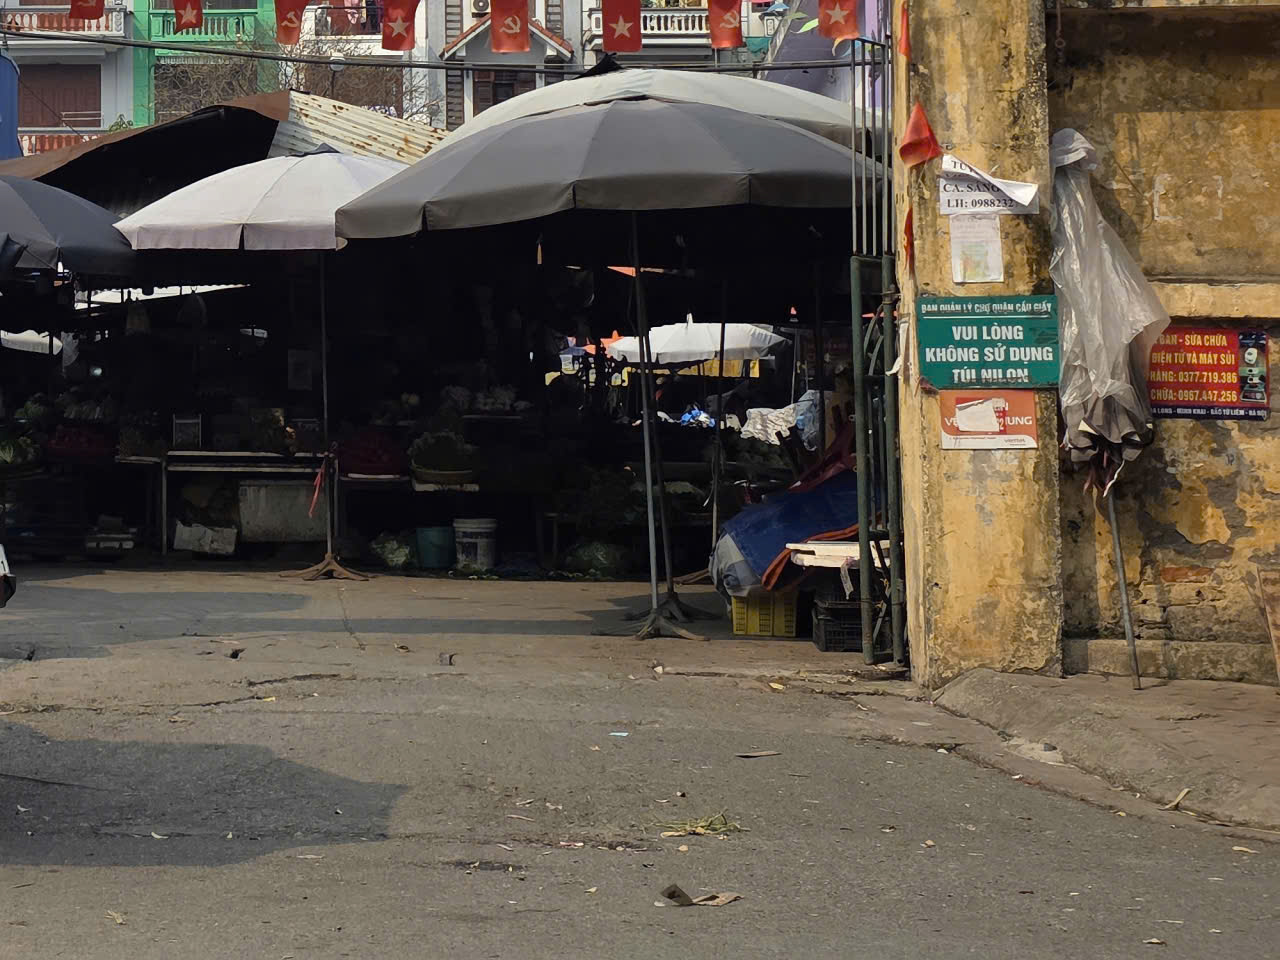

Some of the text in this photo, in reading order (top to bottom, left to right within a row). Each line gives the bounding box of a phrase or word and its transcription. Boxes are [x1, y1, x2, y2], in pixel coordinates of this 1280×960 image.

[947, 198, 969, 208] LH:
[952, 322, 1024, 341] VUI LÒNG
[925, 342, 1053, 365] KHÔNG SỬ DỤNG
[952, 366, 1029, 384] TÚI NILON
